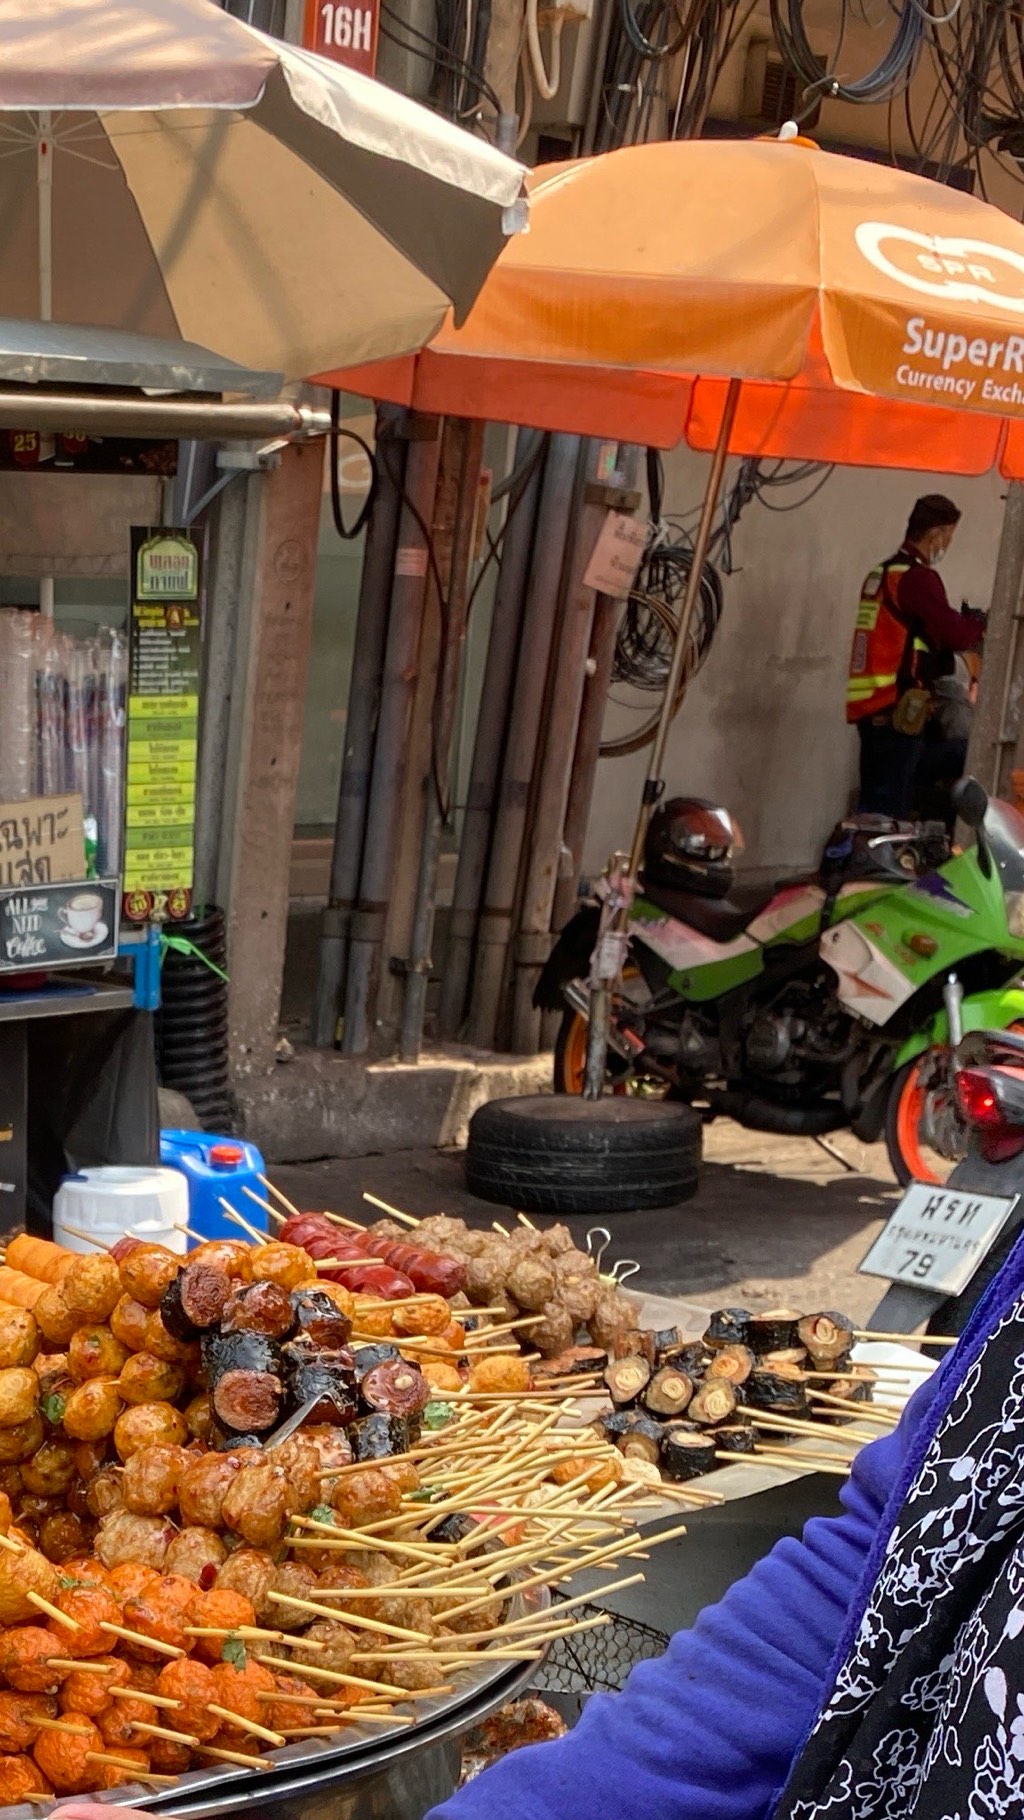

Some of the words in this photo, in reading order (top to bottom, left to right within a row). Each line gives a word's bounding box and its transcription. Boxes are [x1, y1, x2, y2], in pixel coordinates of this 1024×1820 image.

[321, 3, 372, 52] 16H
[896, 365, 976, 400] Currency
[14, 432, 37, 452] 25
[897, 1250, 935, 1278] 79
